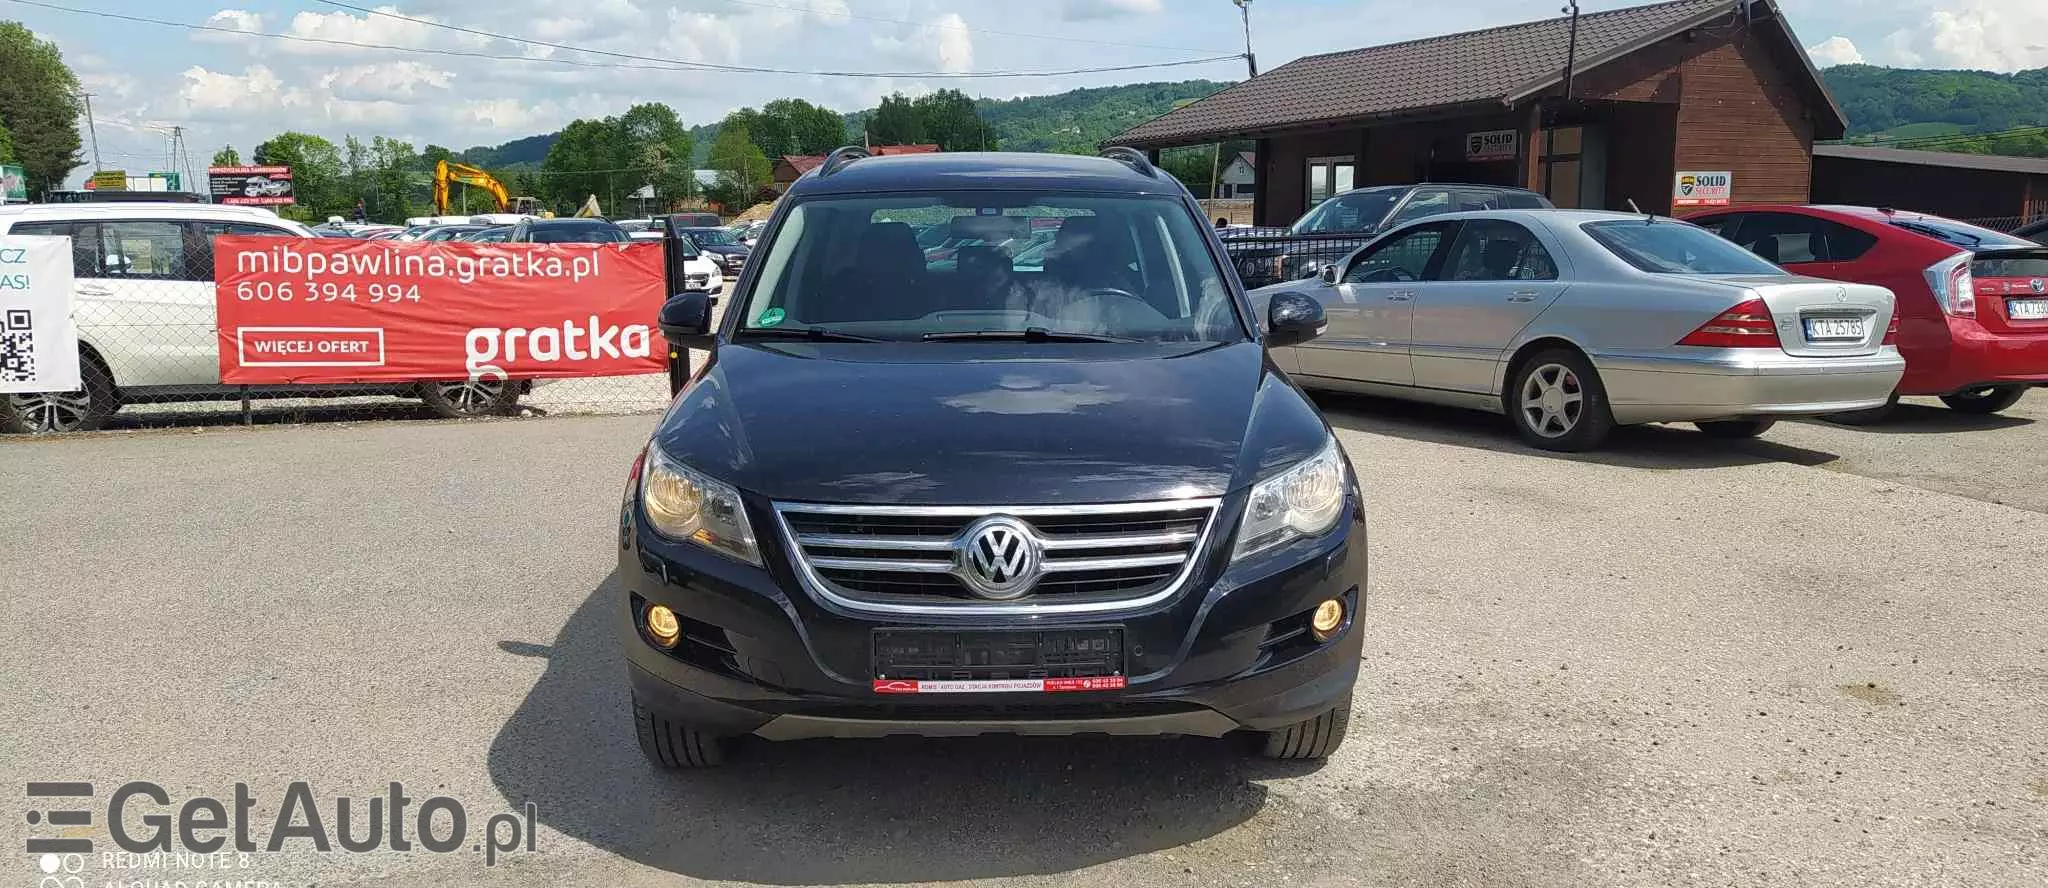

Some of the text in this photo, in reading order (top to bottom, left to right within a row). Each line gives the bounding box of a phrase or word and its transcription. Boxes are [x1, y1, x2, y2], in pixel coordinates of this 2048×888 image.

[1484, 134, 1512, 145] SOLID
[1696, 175, 1726, 187] SOLID
[237, 245, 599, 283] mibpawlina.gratka.pl
[237, 281, 421, 303] 606 394 994
[1813, 319, 1832, 335] KTA
[1835, 319, 1862, 335] 25785
[254, 340, 369, 356] WIĘCEJ OFERT
[465, 315, 650, 381] gratka
